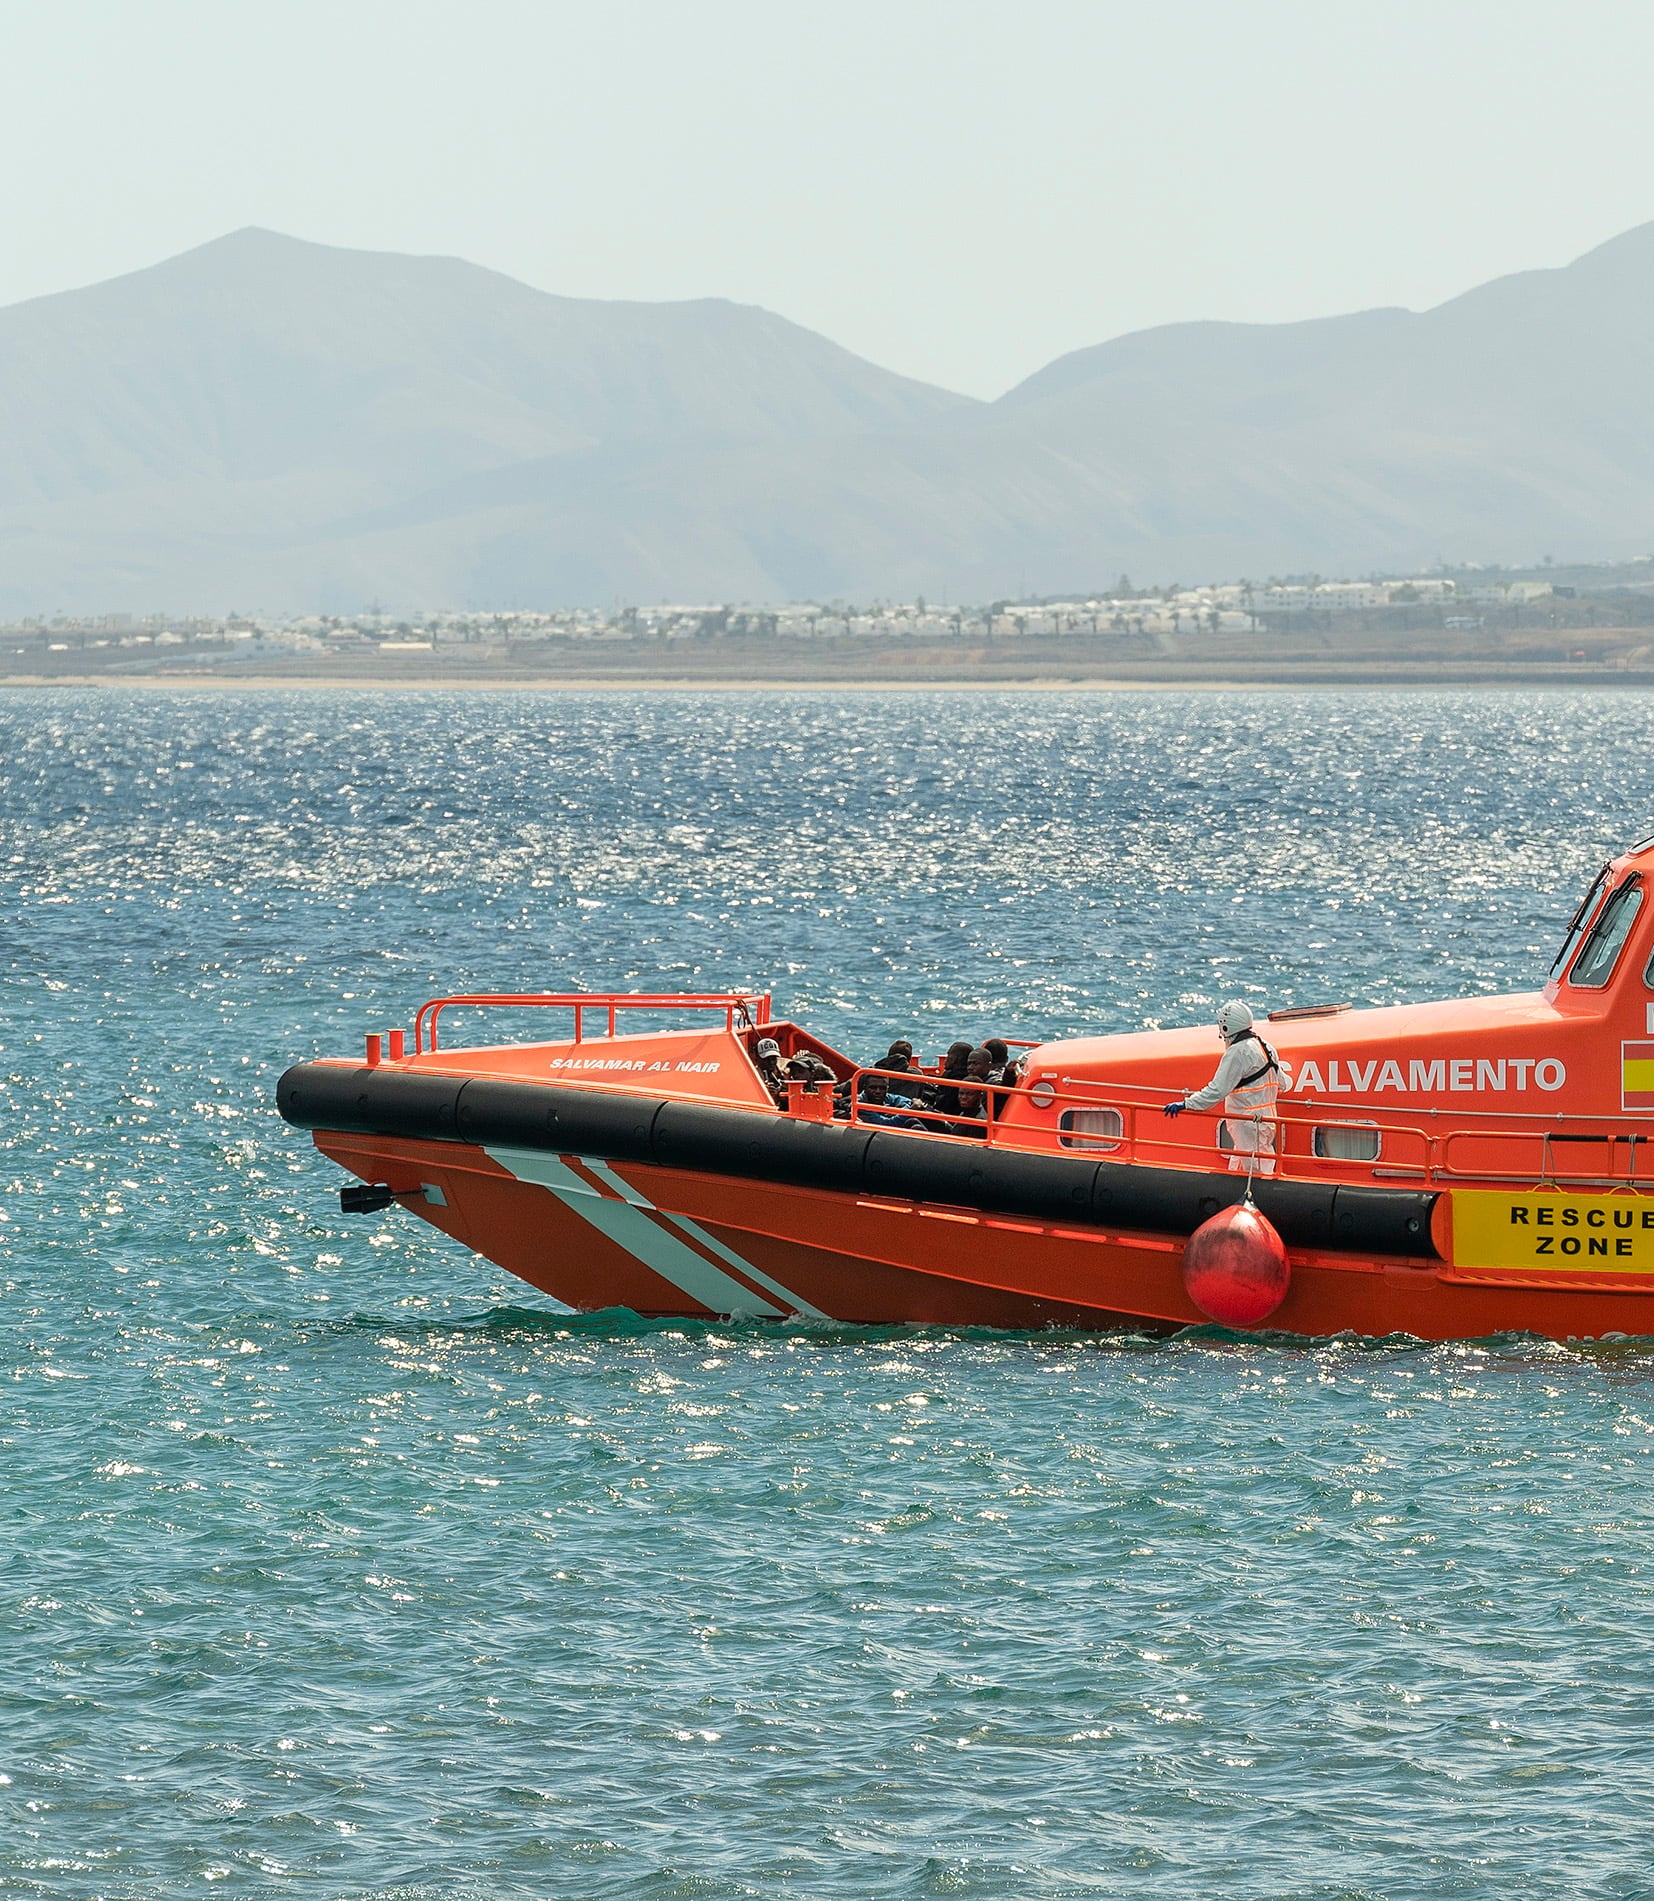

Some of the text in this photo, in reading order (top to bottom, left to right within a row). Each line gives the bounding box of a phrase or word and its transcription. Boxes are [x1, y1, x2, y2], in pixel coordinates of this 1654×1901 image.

[550, 1058, 721, 1073] SALVAMAR AL NAIR
[1536, 1236, 1633, 1256] ZONE
